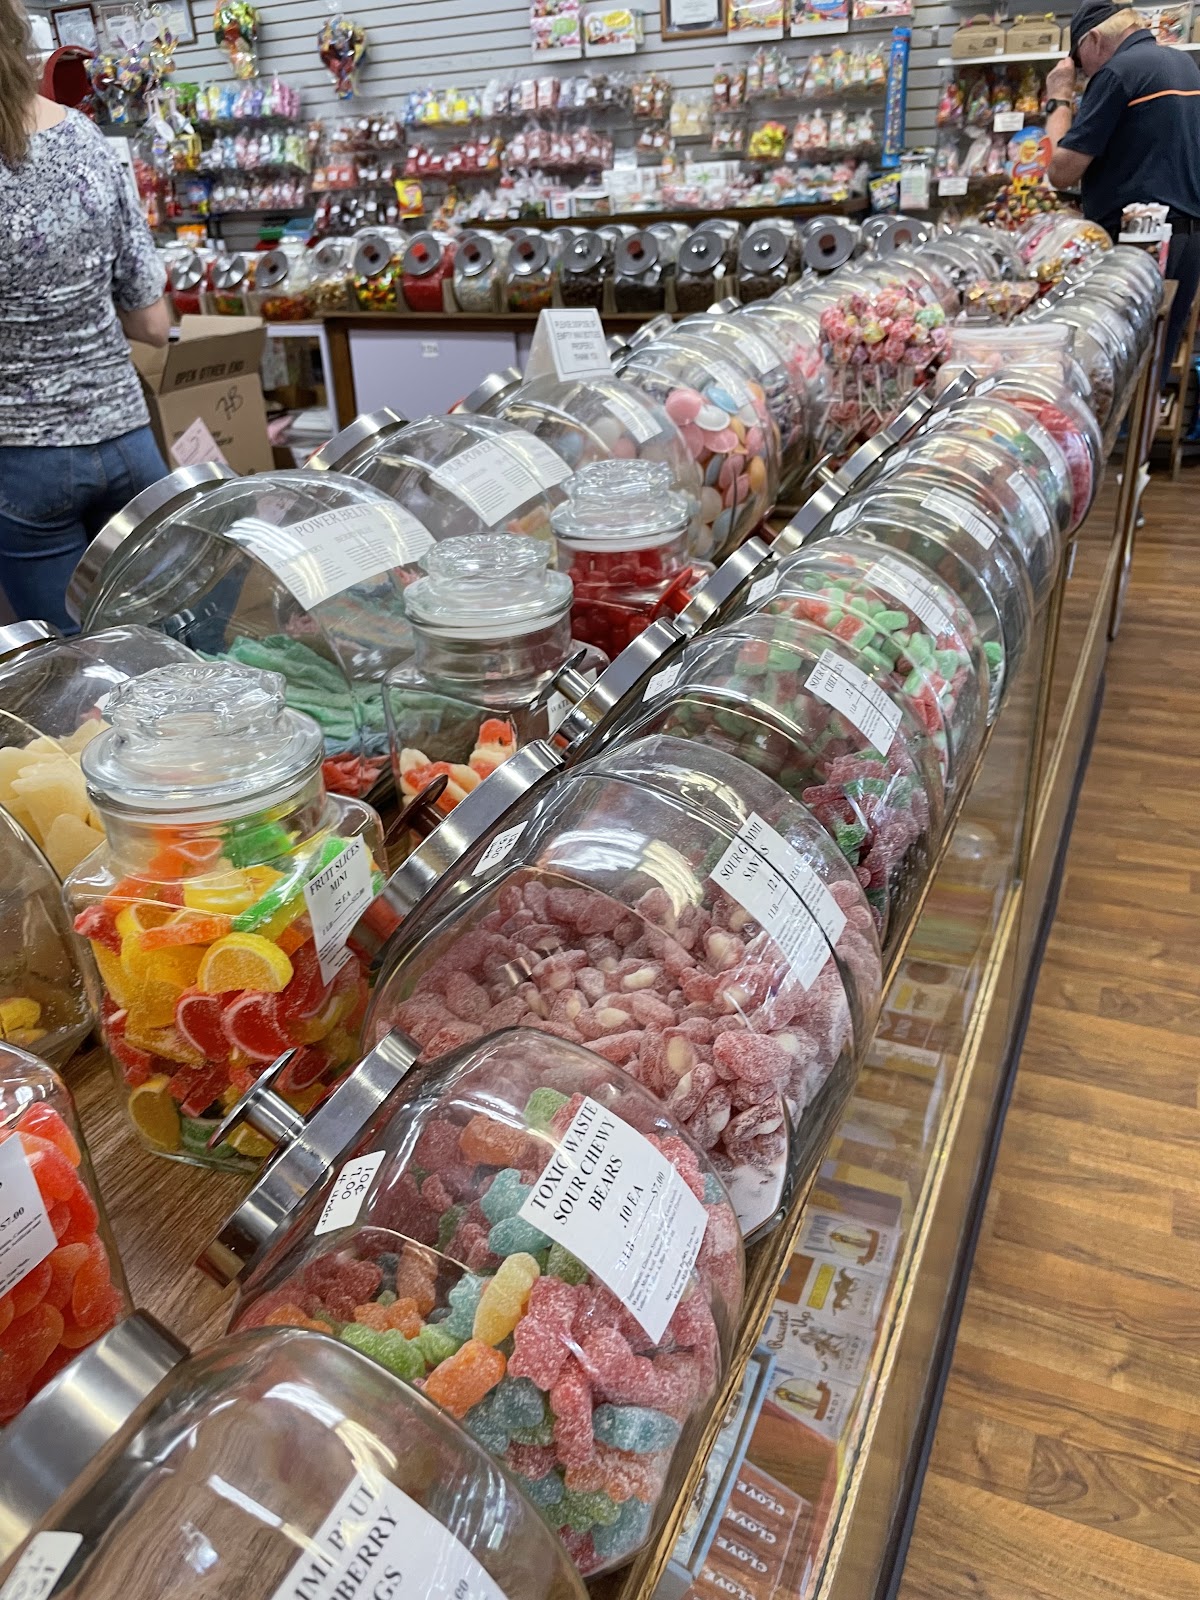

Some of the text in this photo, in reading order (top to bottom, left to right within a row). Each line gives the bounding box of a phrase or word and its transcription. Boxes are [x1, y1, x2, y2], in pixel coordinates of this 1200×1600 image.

[175, 360, 244, 385] OPEN OTHER END
[295, 513, 342, 537] POWER
[340, 504, 371, 523] BELTS
[309, 841, 360, 896] FRUIT SLICES
[720, 821, 764, 881] SOUR GMMI
[743, 844, 770, 882] SANTS
[329, 870, 348, 894] MINI
[530, 1102, 599, 1211] TOXIC WASTE
[553, 1118, 616, 1226] SOUR CHEWY
[587, 1154, 624, 1213] BEARS
[651, 1171, 666, 1198] $7.00
[619, 1184, 644, 1229] .10 EA
[826, 1392, 841, 1422] ANDY
[736, 1480, 785, 1516] CLOVE
[726, 1507, 777, 1544] CLOVE
[716, 1536, 768, 1573] CLOVE
